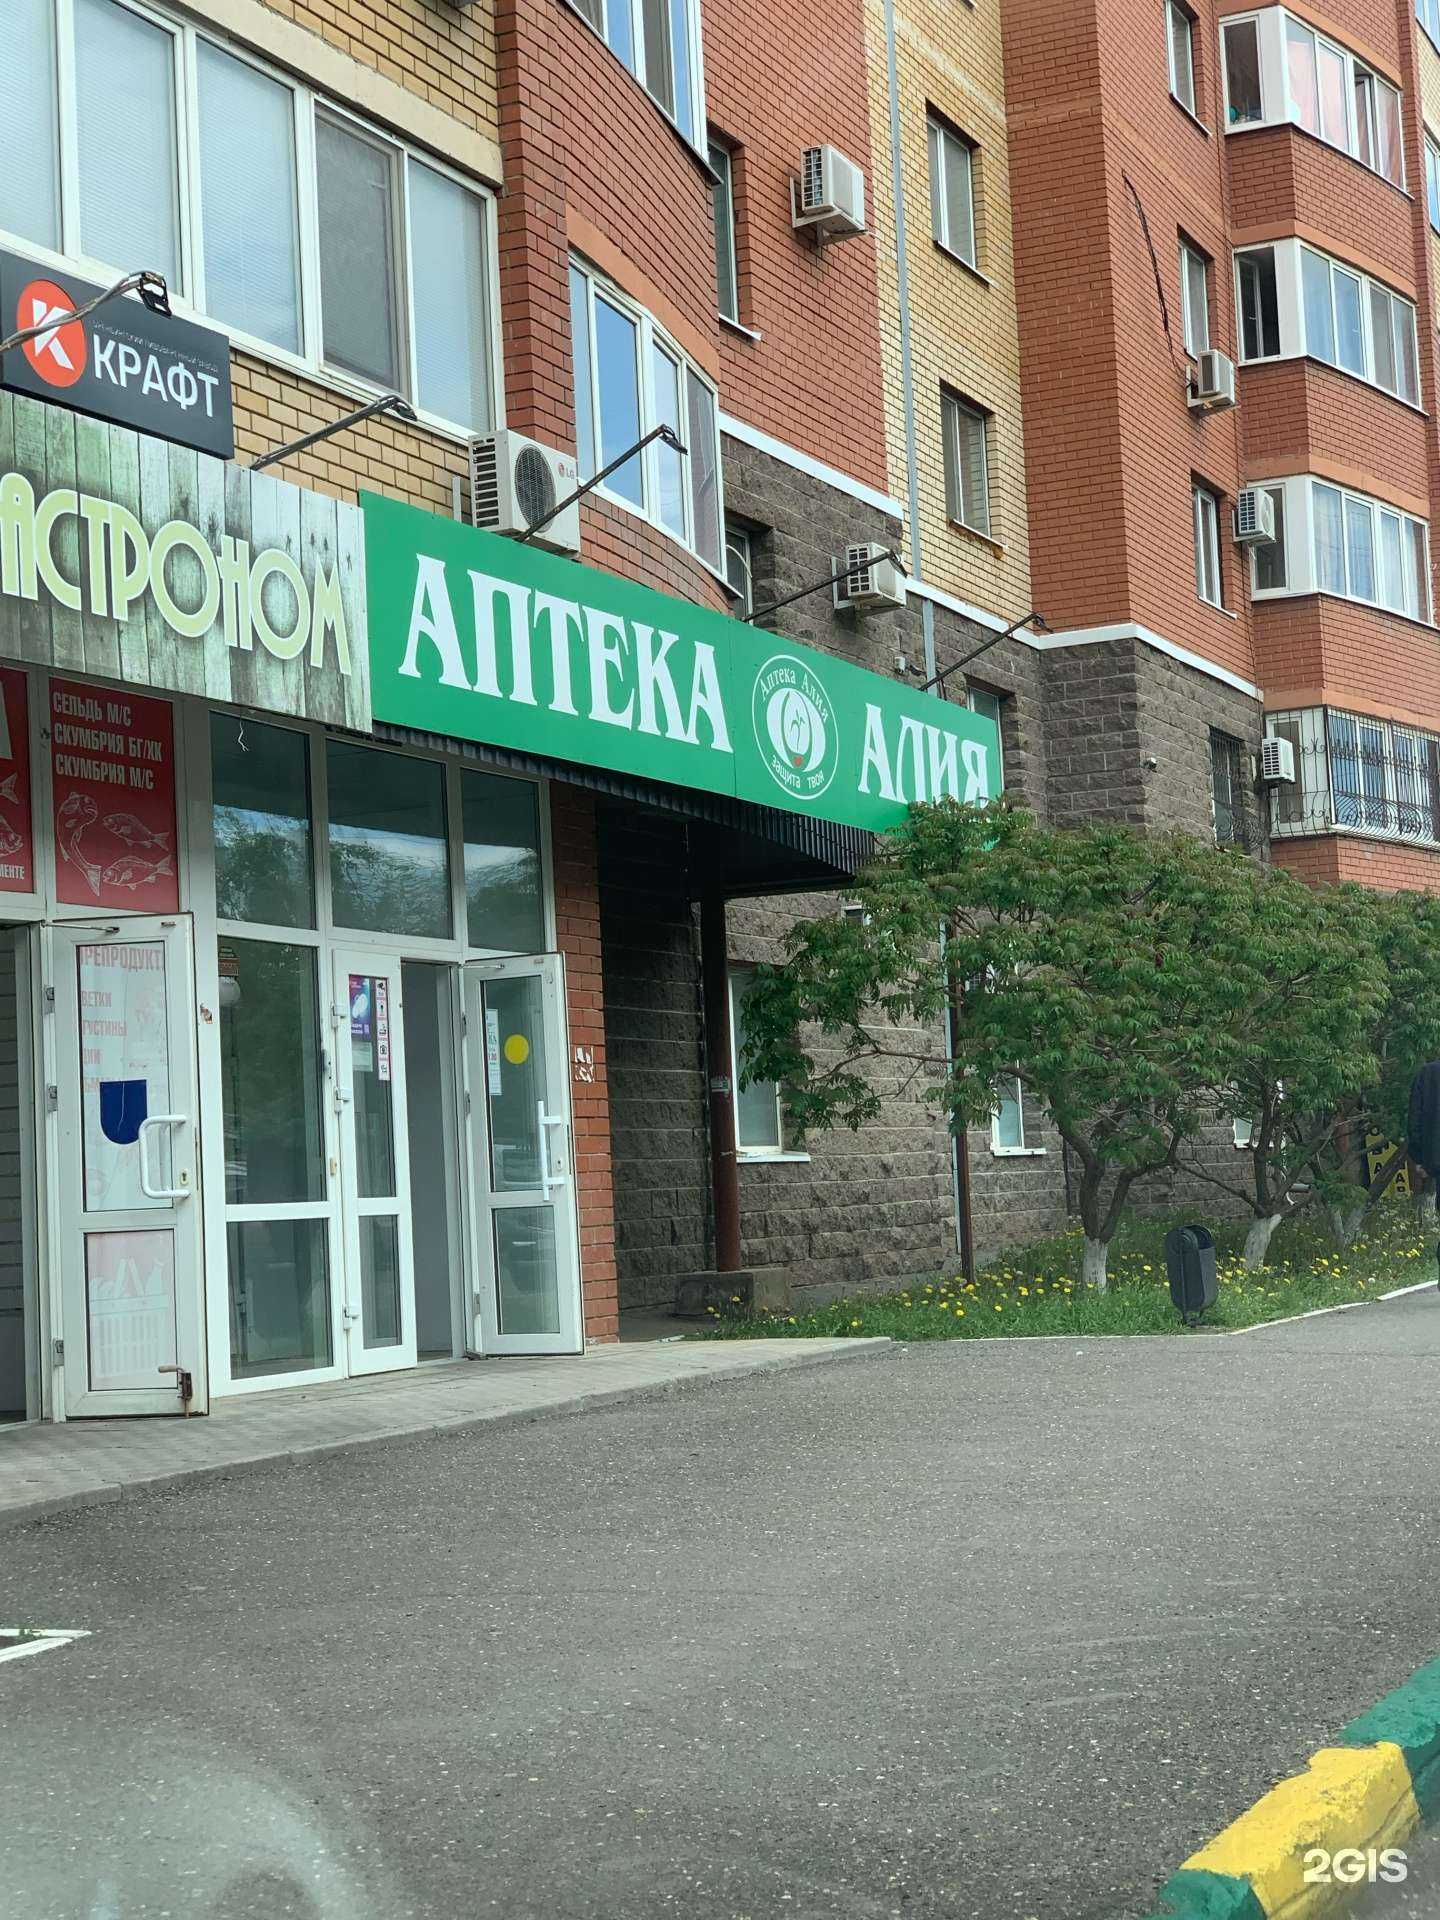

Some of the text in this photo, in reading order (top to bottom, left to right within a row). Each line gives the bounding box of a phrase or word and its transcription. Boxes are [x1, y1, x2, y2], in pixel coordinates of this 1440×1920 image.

[93, 333, 220, 418] КРАФТ
[398, 553, 734, 754] АПТЕКА
[53, 691, 132, 727] СЕЛЬДЬ М/С
[759, 667, 829, 723] Аптека Алия
[54, 722, 124, 755] СКУМБРИЯ
[857, 702, 990, 809] АЛИЯ
[55, 753, 154, 790] СКУМБРИЯ М/С
[80, 945, 165, 973] РЕПРОДУКТ
